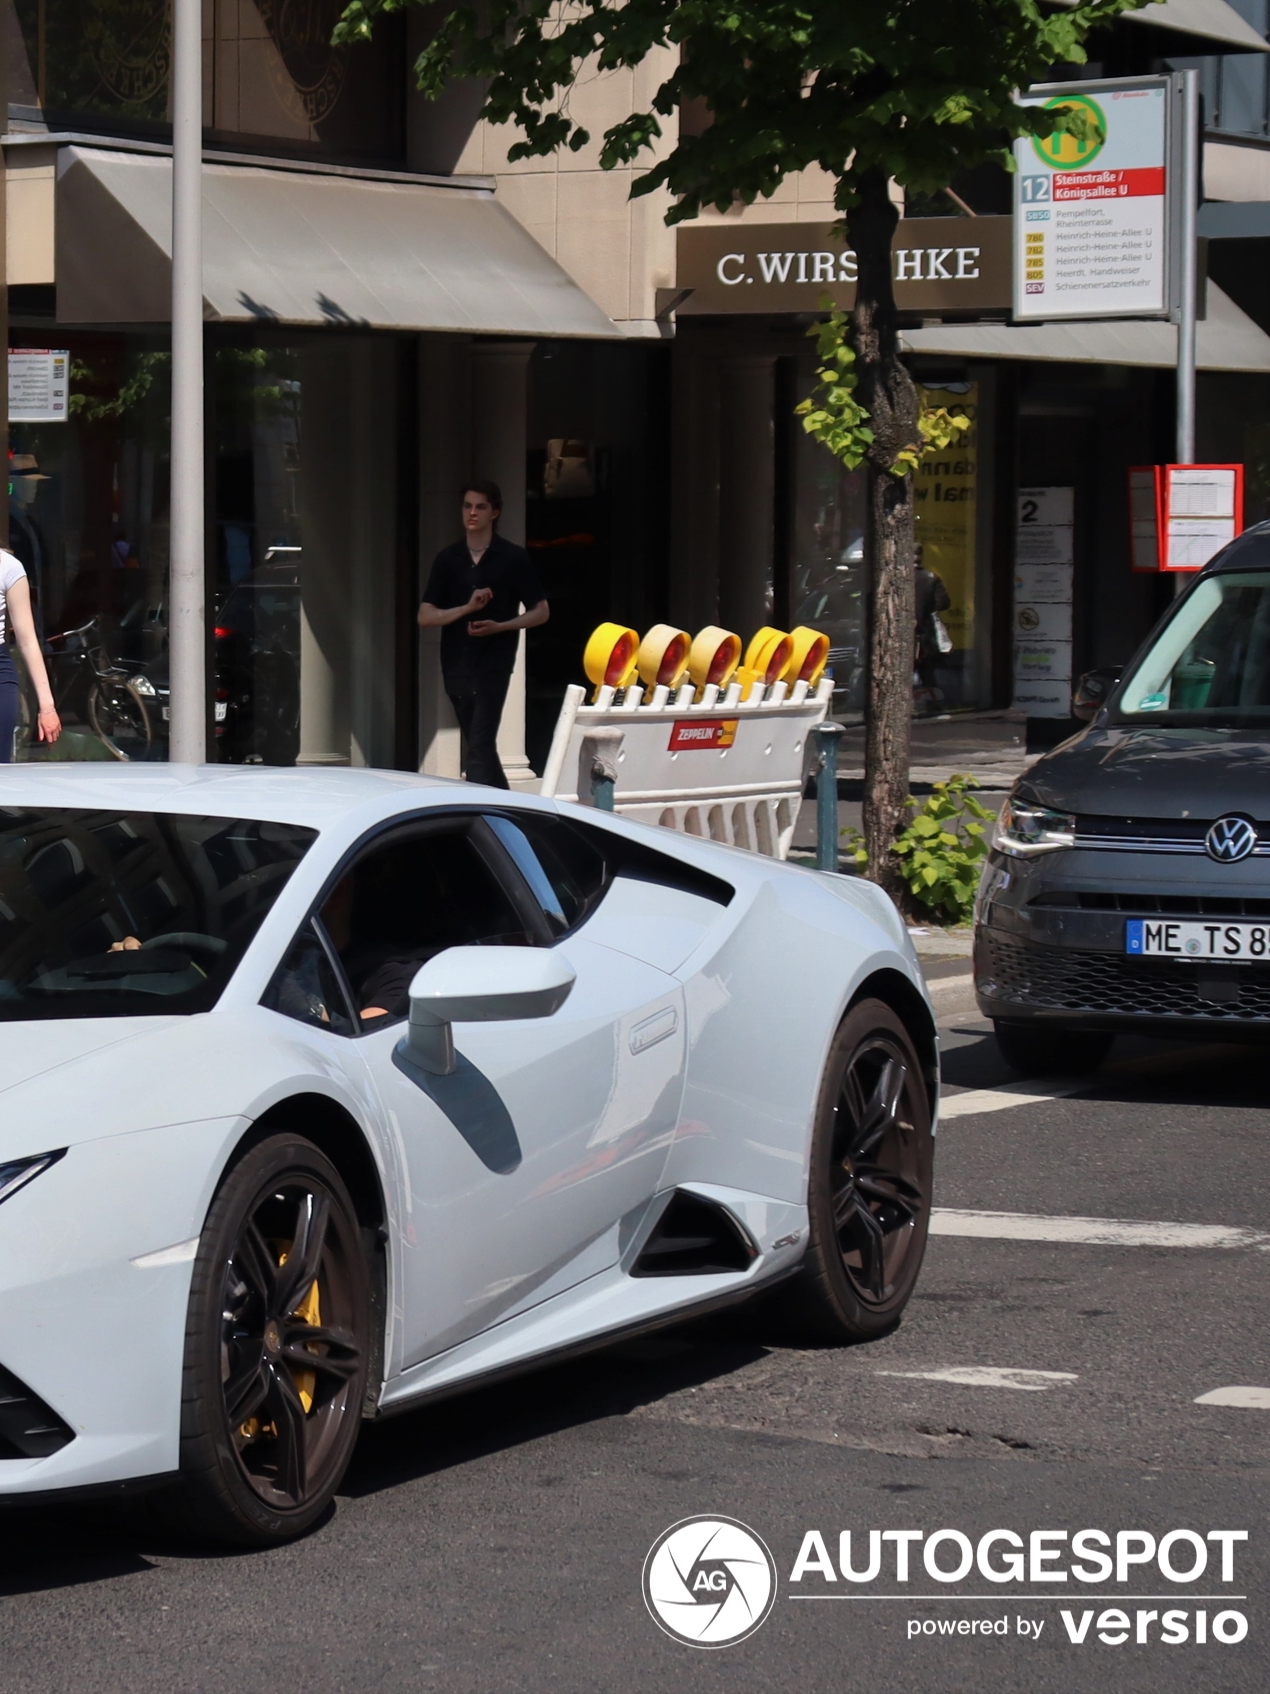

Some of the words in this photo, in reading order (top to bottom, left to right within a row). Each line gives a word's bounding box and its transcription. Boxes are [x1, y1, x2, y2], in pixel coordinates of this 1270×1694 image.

[1056, 172, 1116, 186] Steinstraße
[1023, 176, 1049, 201] 12
[1056, 185, 1117, 200] Königsallee
[1119, 184, 1128, 196] U
[1026, 210, 1051, 221] SB50
[1056, 217, 1113, 228] Rheinterrasse
[1056, 228, 1143, 241] Heinrich-Heine-Allee
[1056, 241, 1143, 253] Heinrich-Heine-Allee
[717, 247, 980, 285] C.WIRSHKE
[1056, 253, 1143, 265] Heinrich-Heine-Allee
[1090, 265, 1141, 276] Handweiser
[1026, 283, 1044, 294] SEV
[1056, 279, 1151, 291] Schienenersatzverkehr
[1021, 500, 1039, 522] 2
[677, 727, 715, 741] ZEPPELIN
[1145, 923, 1182, 952] ME
[1204, 926, 1241, 954] TS
